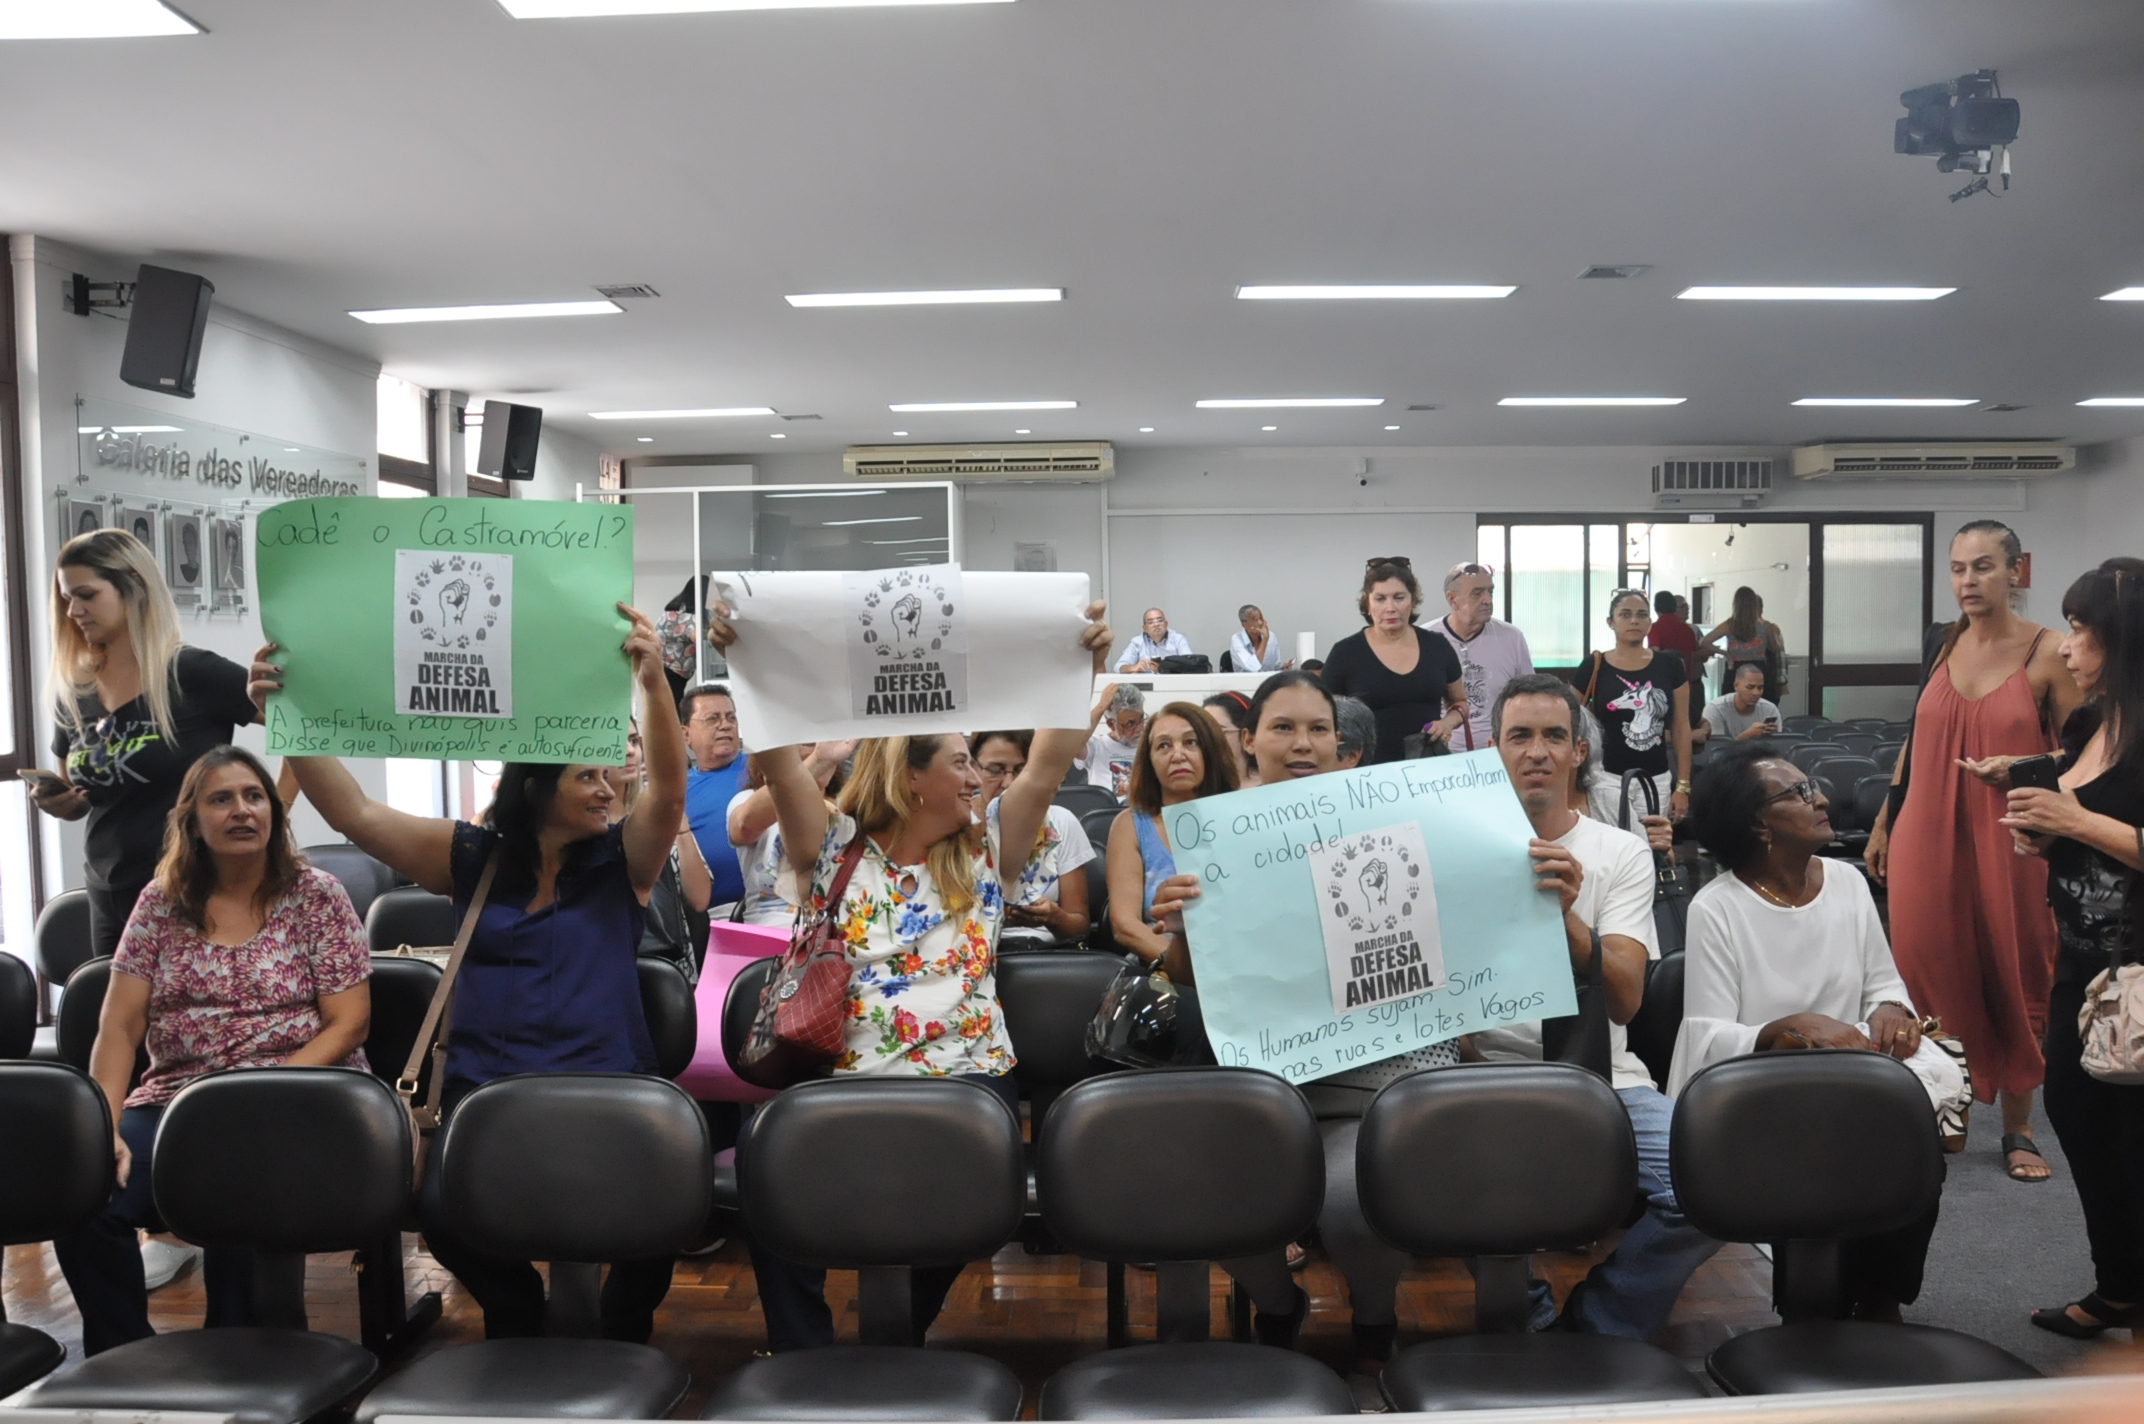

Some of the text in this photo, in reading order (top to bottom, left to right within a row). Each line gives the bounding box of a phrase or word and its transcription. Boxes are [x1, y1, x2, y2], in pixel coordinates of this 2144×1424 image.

[95, 431, 359, 497] Galeria das Vereadoras
[256, 504, 626, 550] Cadê o Castramóvel?
[418, 663, 491, 688] DEFESA
[424, 651, 484, 665] MARCHA DA
[879, 661, 940, 675] MARCHA DA
[409, 685, 500, 714] ANIMAL
[873, 672, 947, 693] DEFESA
[866, 690, 956, 715] ANIMAL
[271, 704, 287, 732] A
[301, 707, 396, 741] prefeitura
[463, 718, 518, 743] quis
[534, 711, 623, 741] parceria
[271, 729, 623, 760] Disse que Divinópolis é autosuficiente
[1175, 759, 1507, 850] Os animais NÃO Emporcalham
[1204, 818, 1346, 883] a cidade!
[1350, 941, 1423, 979] DEFESA
[1354, 930, 1414, 954] MARCHA DA
[1346, 962, 1433, 1008] ANIMAL
[1221, 1041, 1250, 1067] Os
[1259, 1014, 1354, 1062] Humanos
[1366, 992, 1434, 1027] sujam
[1281, 991, 1545, 1080] nas ruas e lotes Vagos
